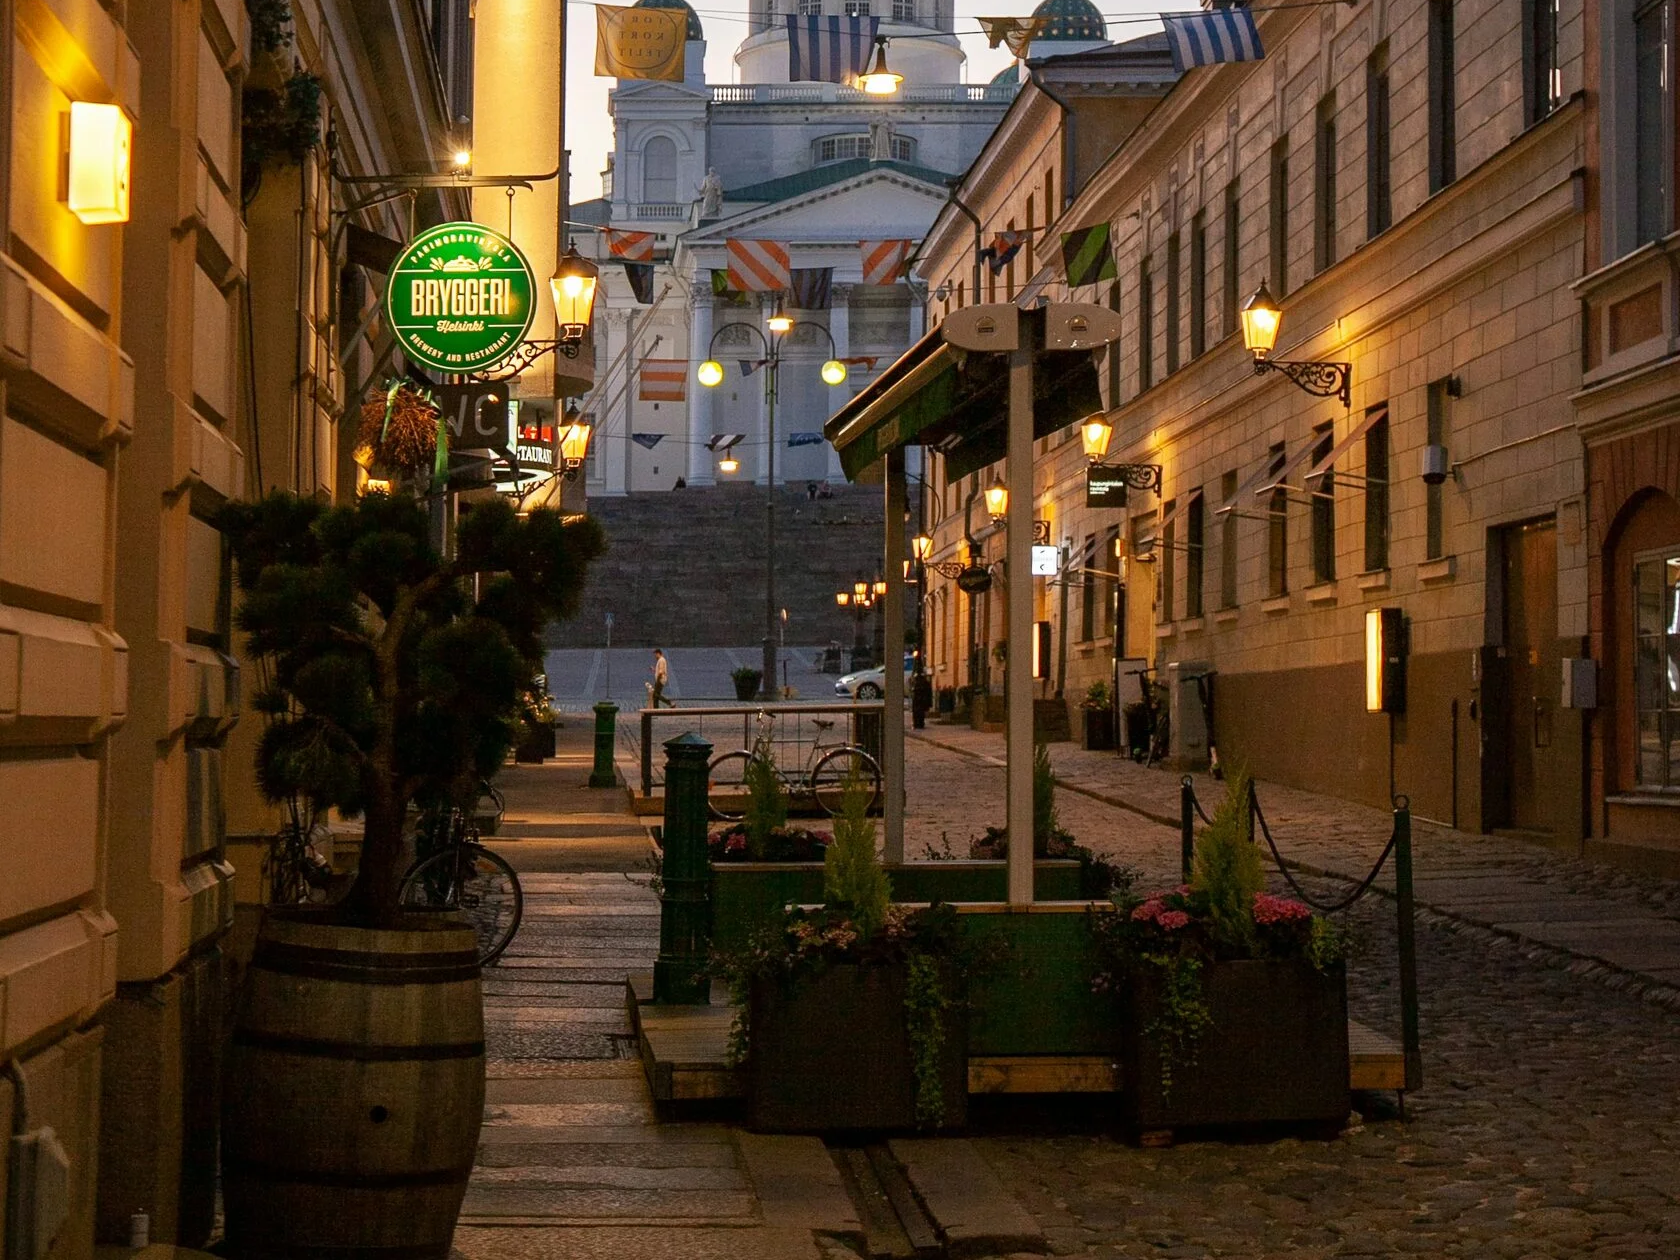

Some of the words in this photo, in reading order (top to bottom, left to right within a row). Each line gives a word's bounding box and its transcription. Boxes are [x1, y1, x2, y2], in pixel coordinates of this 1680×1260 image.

[411, 278, 511, 316] BRYGGERI
[436, 319, 485, 333] Helsinki
[409, 333, 443, 359] BREWERY
[446, 353, 462, 362] AND
[465, 331, 512, 362] RESTAURANT
[438, 394, 498, 436] WC
